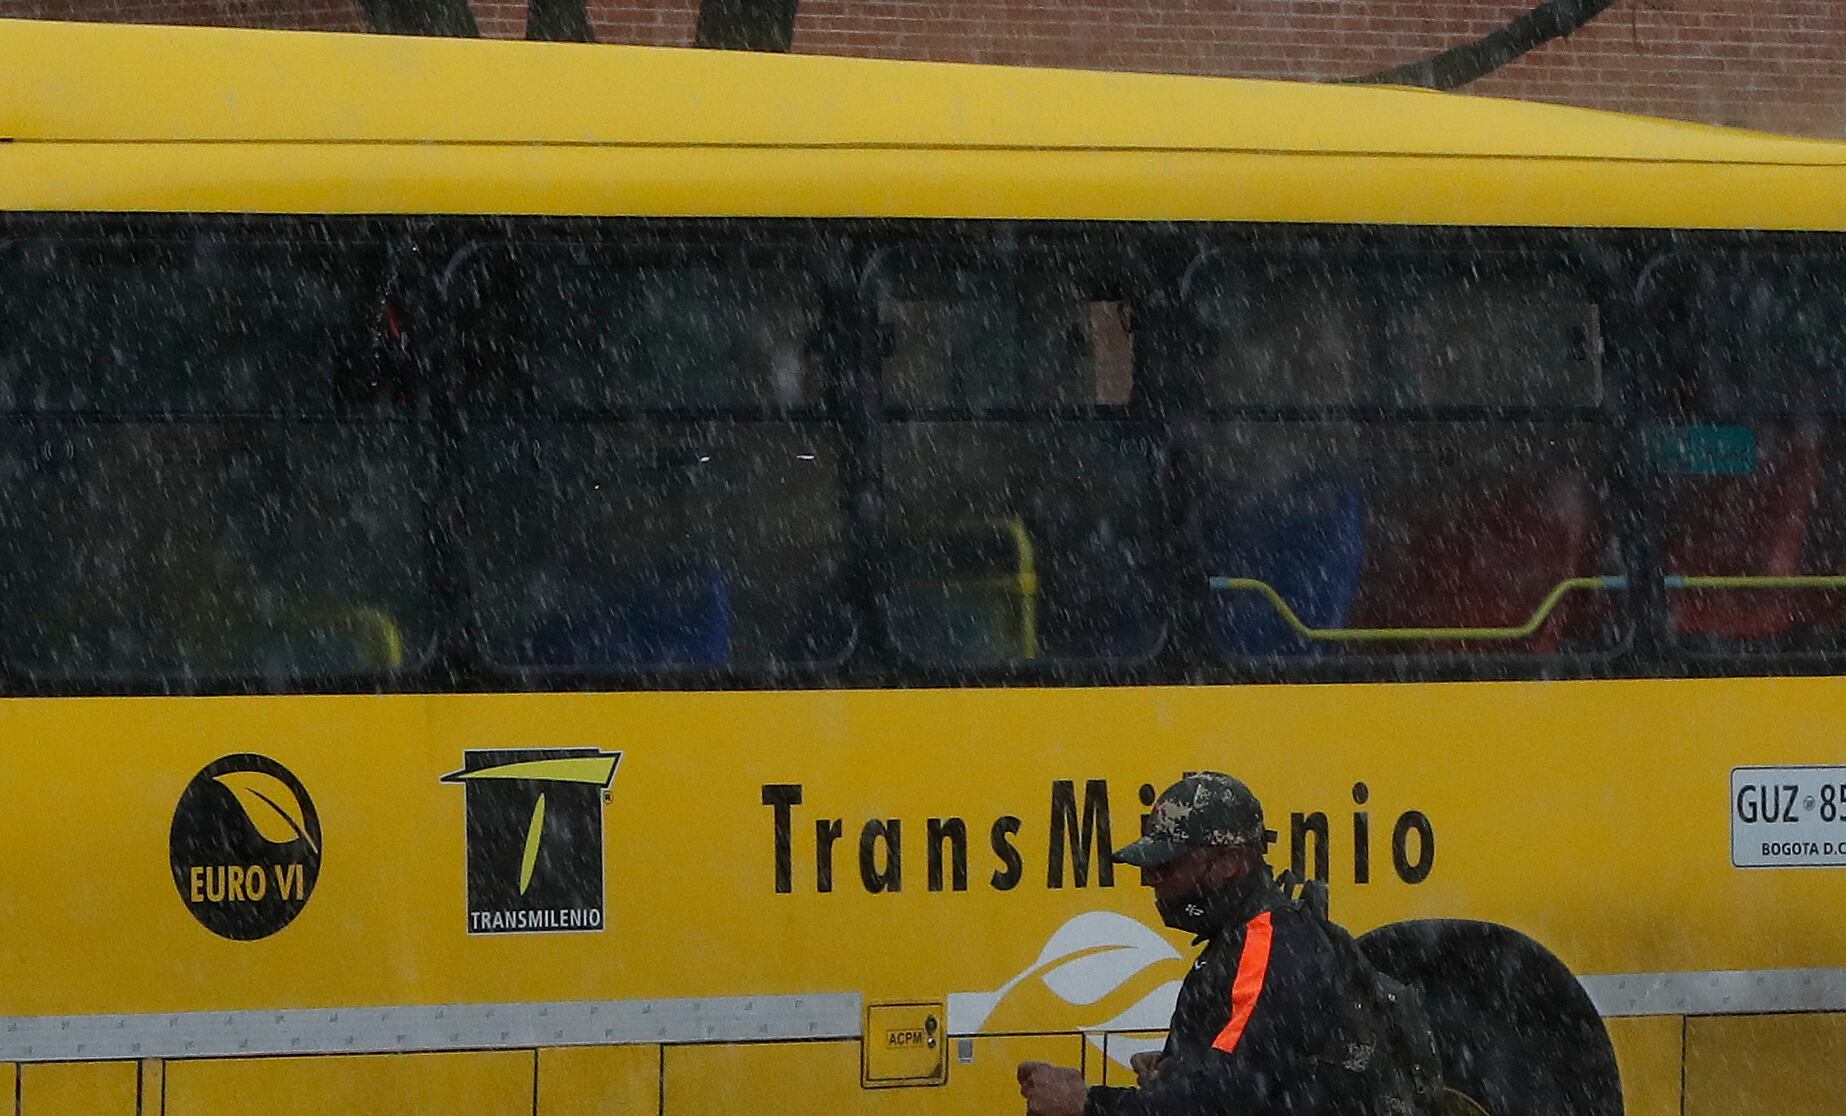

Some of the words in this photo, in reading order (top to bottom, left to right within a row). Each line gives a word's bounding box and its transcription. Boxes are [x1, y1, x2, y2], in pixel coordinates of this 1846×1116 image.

[1736, 784, 1800, 823] GUZ
[1761, 842, 1820, 856] BOGOTA
[189, 864, 267, 903] EURO
[274, 862, 304, 902] VI
[470, 907, 601, 931] TRANSMILENIO
[888, 1031, 922, 1046] ACPM
